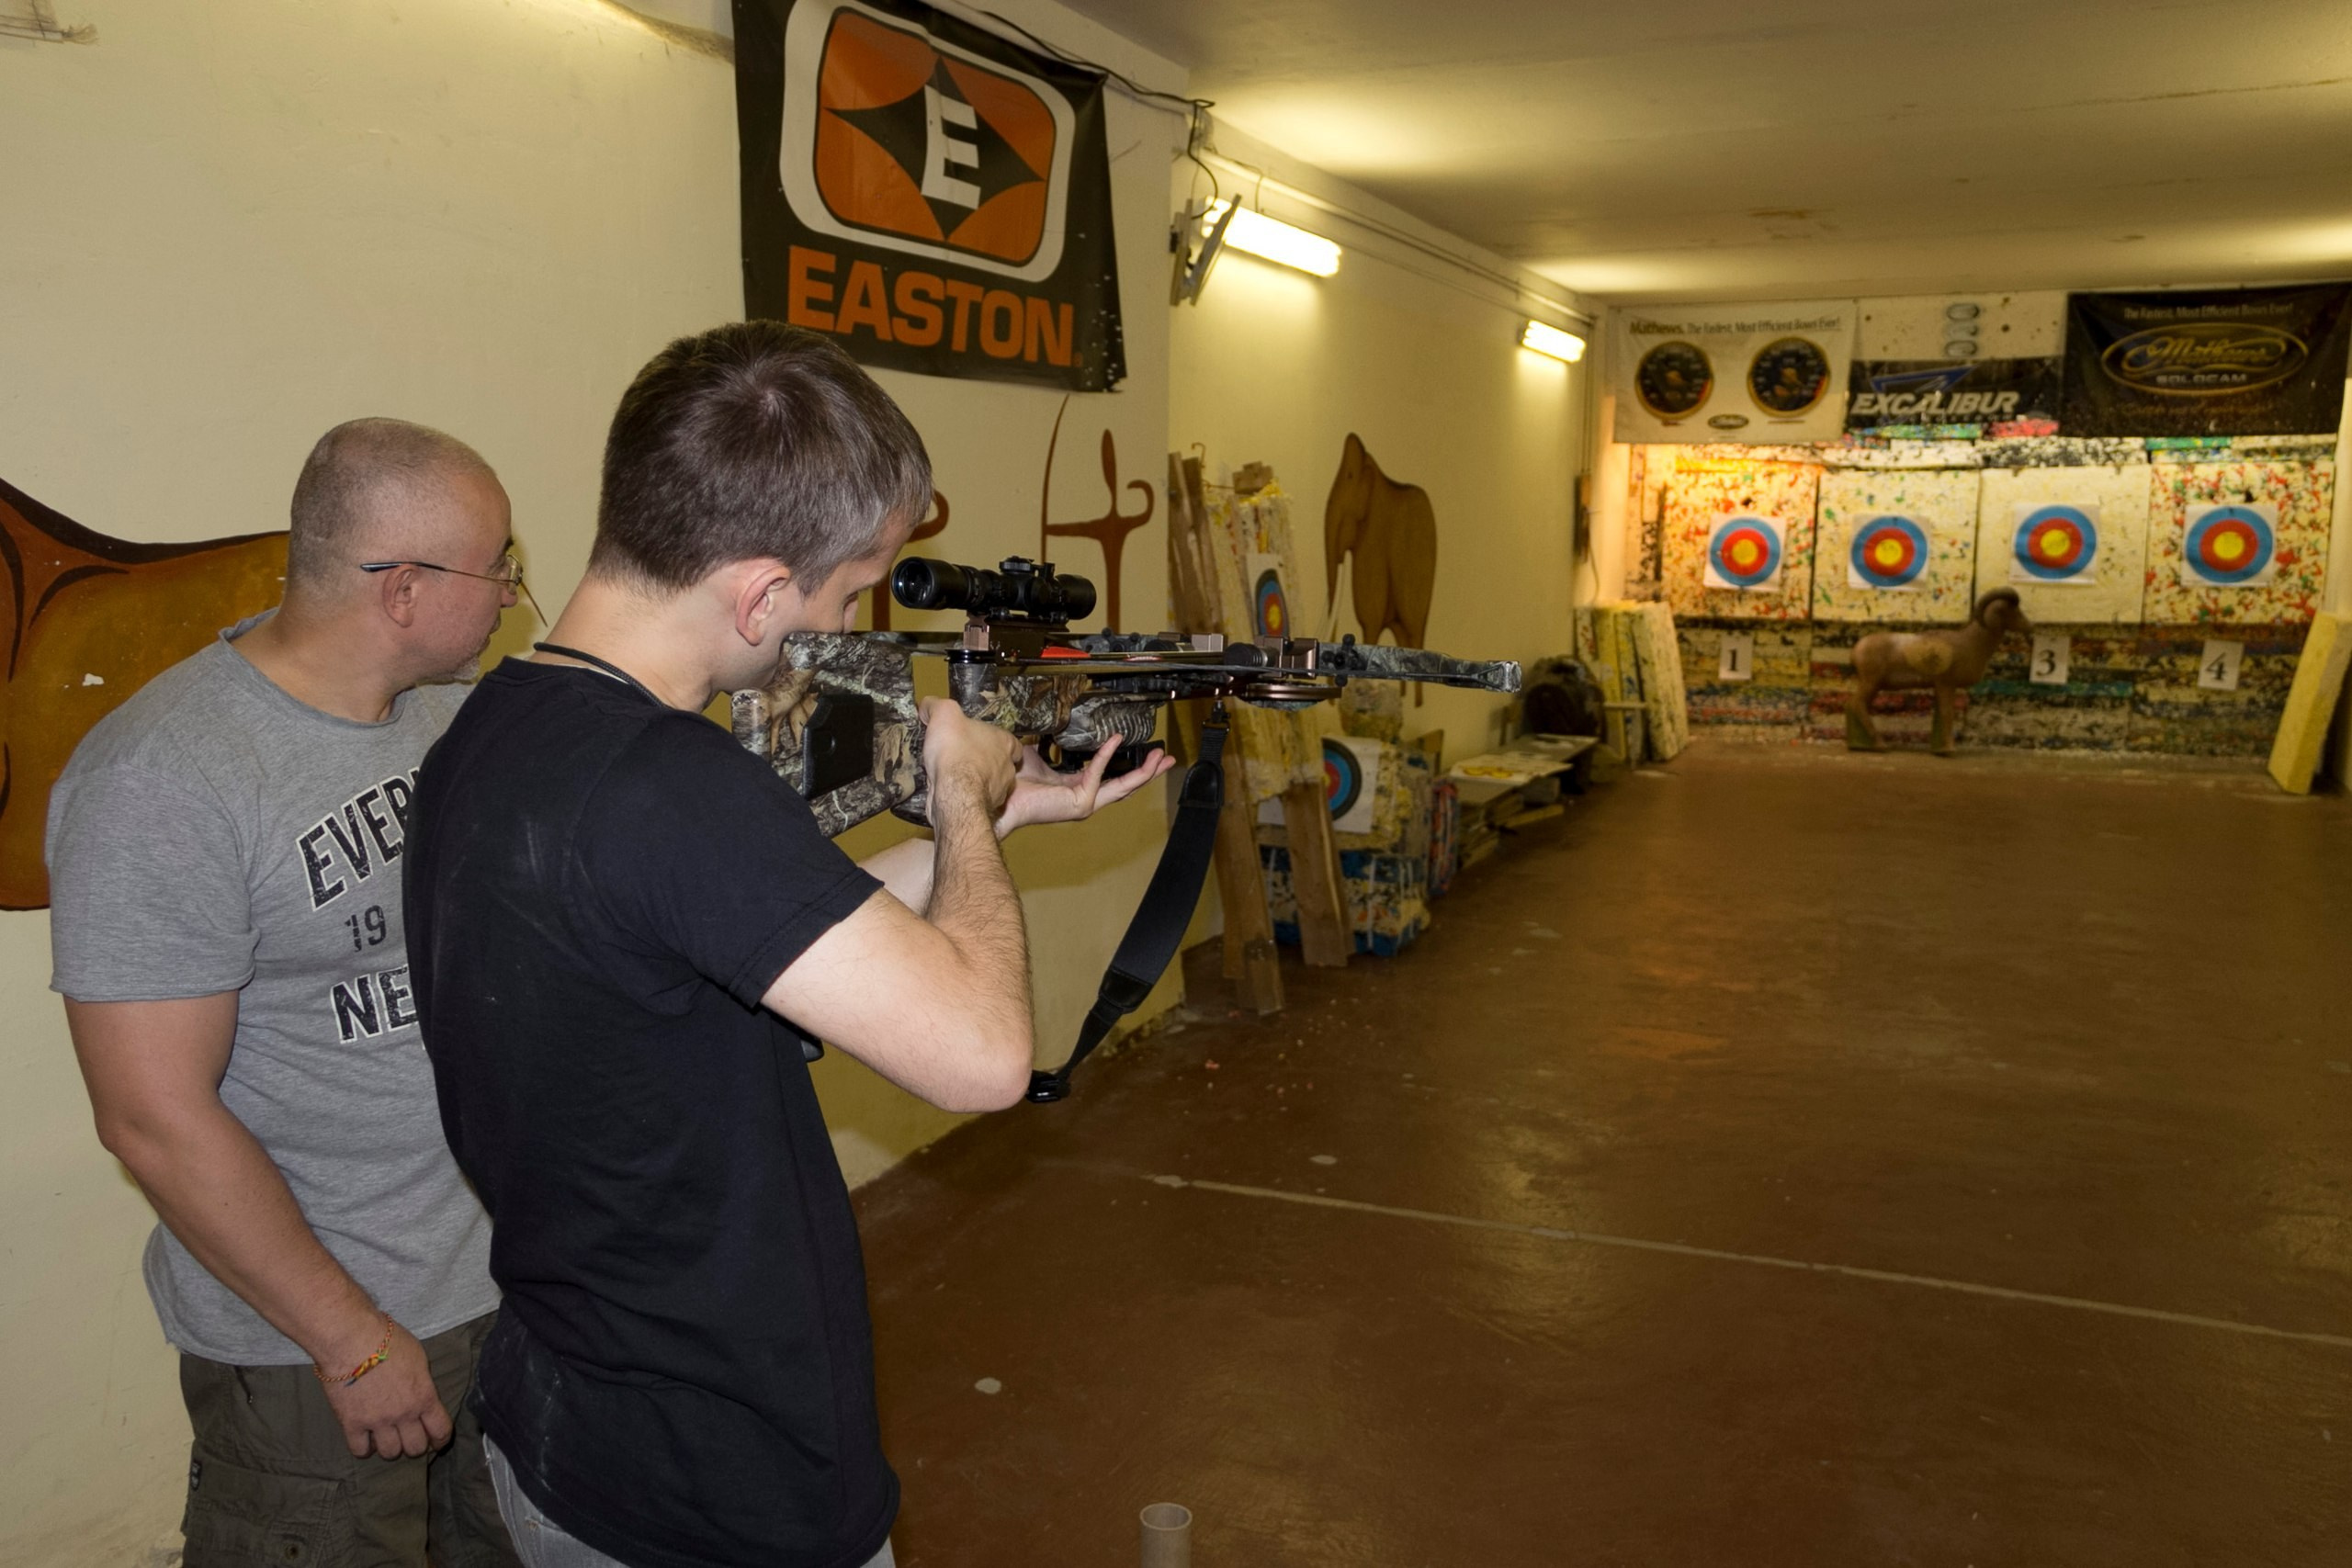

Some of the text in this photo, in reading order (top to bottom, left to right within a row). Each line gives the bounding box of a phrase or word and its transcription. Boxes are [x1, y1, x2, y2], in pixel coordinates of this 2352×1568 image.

[921, 85, 981, 210] E
[787, 245, 1074, 367] EASTON
[2124, 307, 2139, 319] The
[2177, 306, 2199, 318] Most
[2201, 304, 2240, 317] Efficient
[2242, 303, 2267, 315] Bows
[1736, 321, 1756, 333] Most
[1758, 320, 1792, 332] Efficient
[2155, 373, 2247, 384] SOLOCAM
[1849, 390, 2020, 416] EXCALIBUR
[1728, 649, 1738, 671] 1
[2035, 649, 2056, 676] 3
[2205, 651, 2228, 681] 4
[295, 766, 421, 912] EVER
[344, 904, 388, 953] 19
[330, 963, 421, 1045] NE
